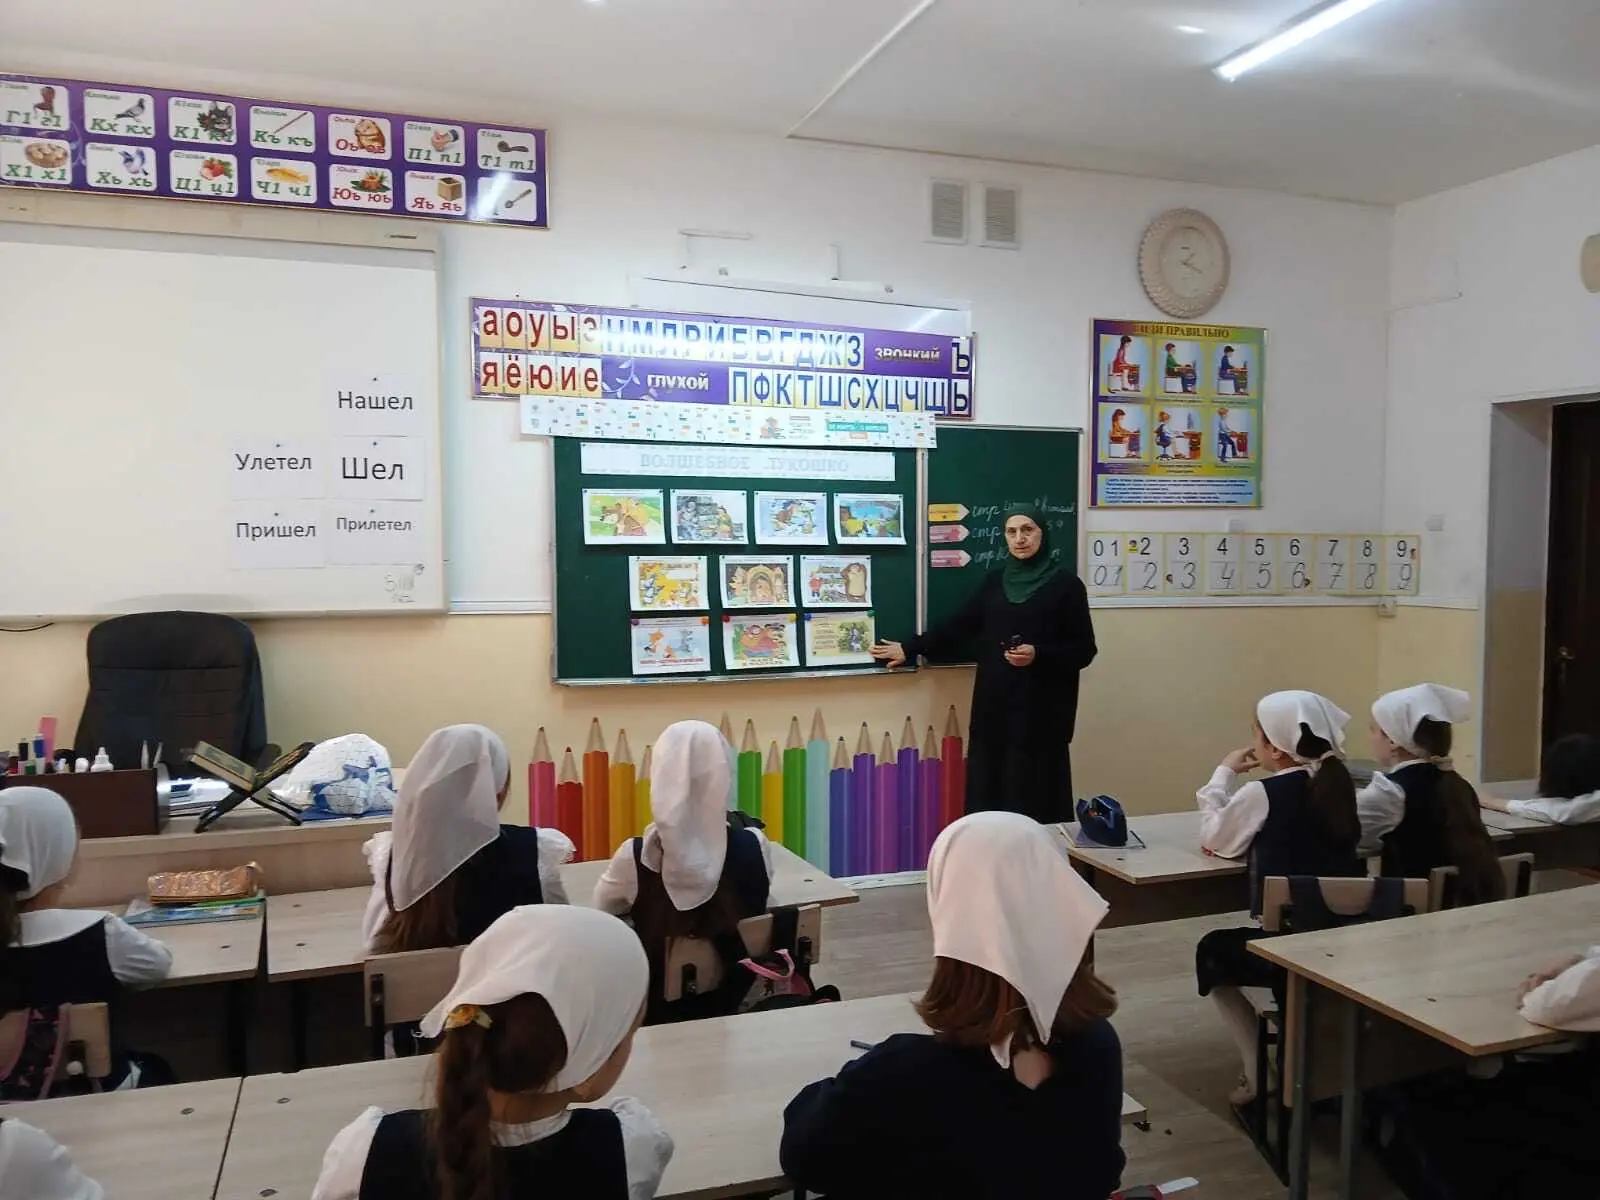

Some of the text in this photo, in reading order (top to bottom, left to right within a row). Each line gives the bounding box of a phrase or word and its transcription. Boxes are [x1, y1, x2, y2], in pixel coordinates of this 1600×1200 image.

[1167, 325, 1230, 338] ПРАВИЛЬНО
[647, 372, 709, 390] ГЛУХОЙ
[337, 390, 413, 410] Нашел
[235, 453, 312, 470] Улетел
[341, 457, 404, 480] Шел
[236, 522, 316, 541] Пришел
[336, 517, 412, 532] Прилетел
[1093, 537, 1407, 557] 0 1 2 3 4 5 6 7 8 9
